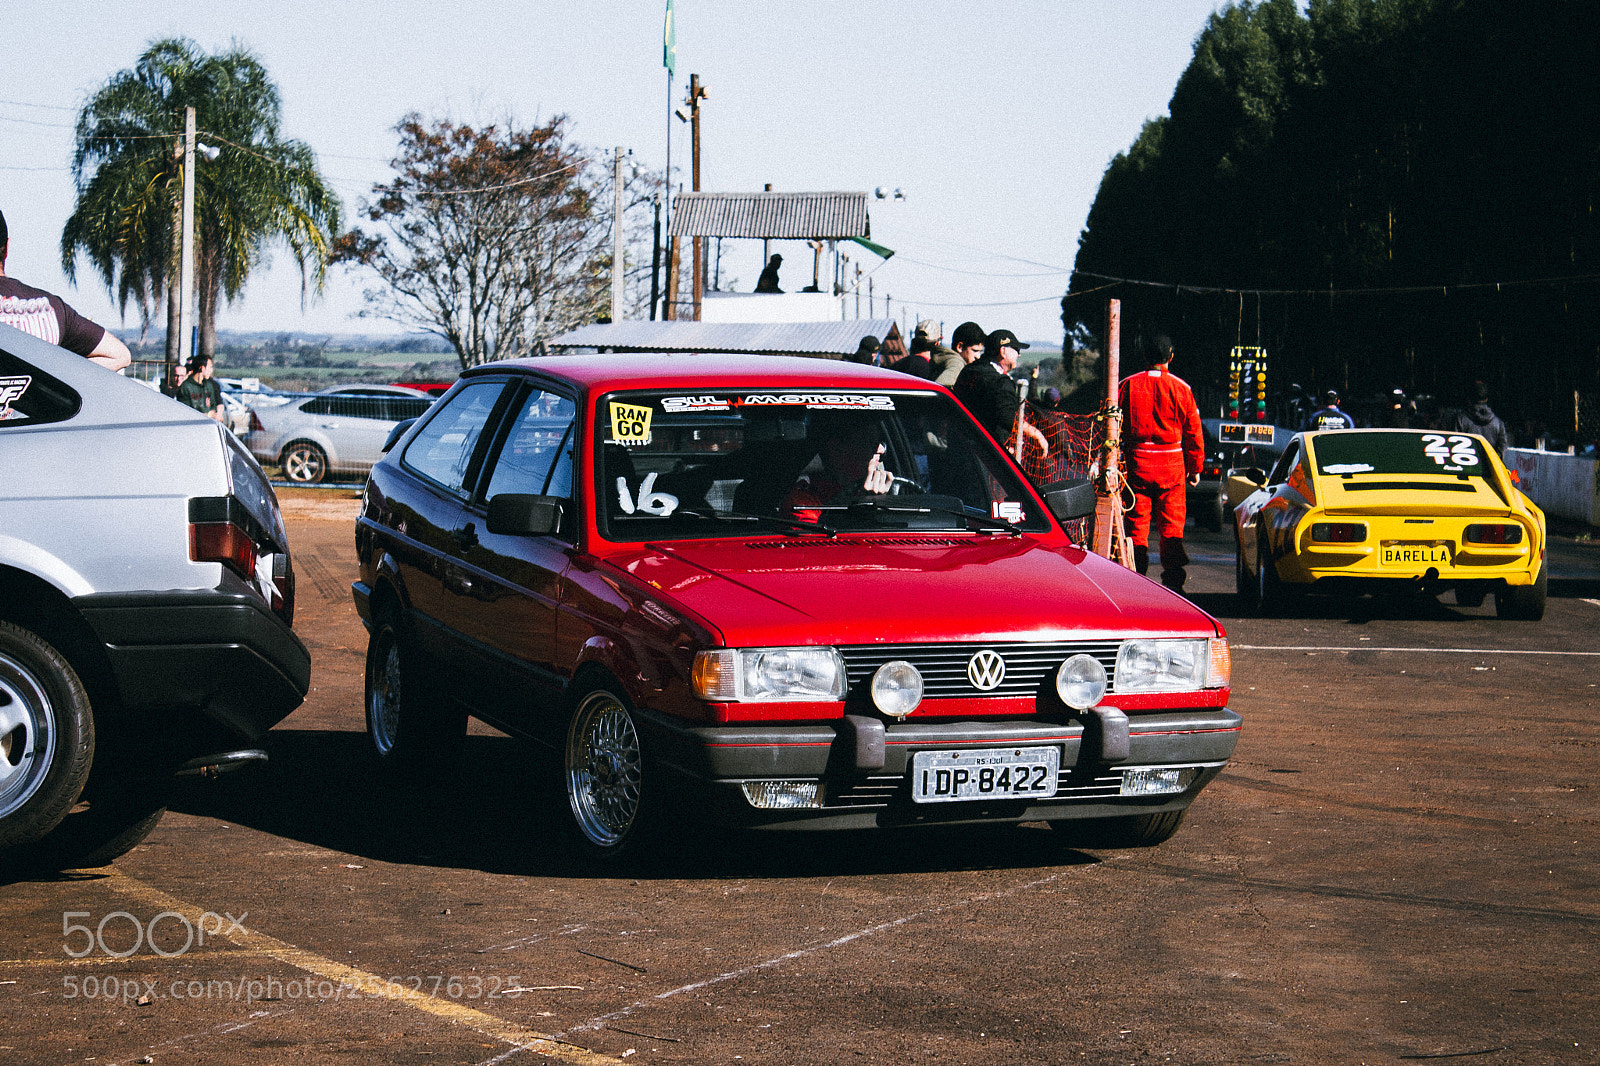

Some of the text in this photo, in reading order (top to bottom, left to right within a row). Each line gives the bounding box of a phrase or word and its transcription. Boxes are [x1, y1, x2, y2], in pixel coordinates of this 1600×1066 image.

[661, 395, 894, 407] SUL MOTORS
[616, 407, 647, 422] RAN
[618, 421, 643, 436] GO
[1421, 434, 1477, 454] 22
[1425, 452, 1479, 466] TO
[617, 472, 679, 516] 16
[992, 501, 1021, 518] 16
[1385, 550, 1447, 562] BARELLA
[968, 650, 1005, 690] VW
